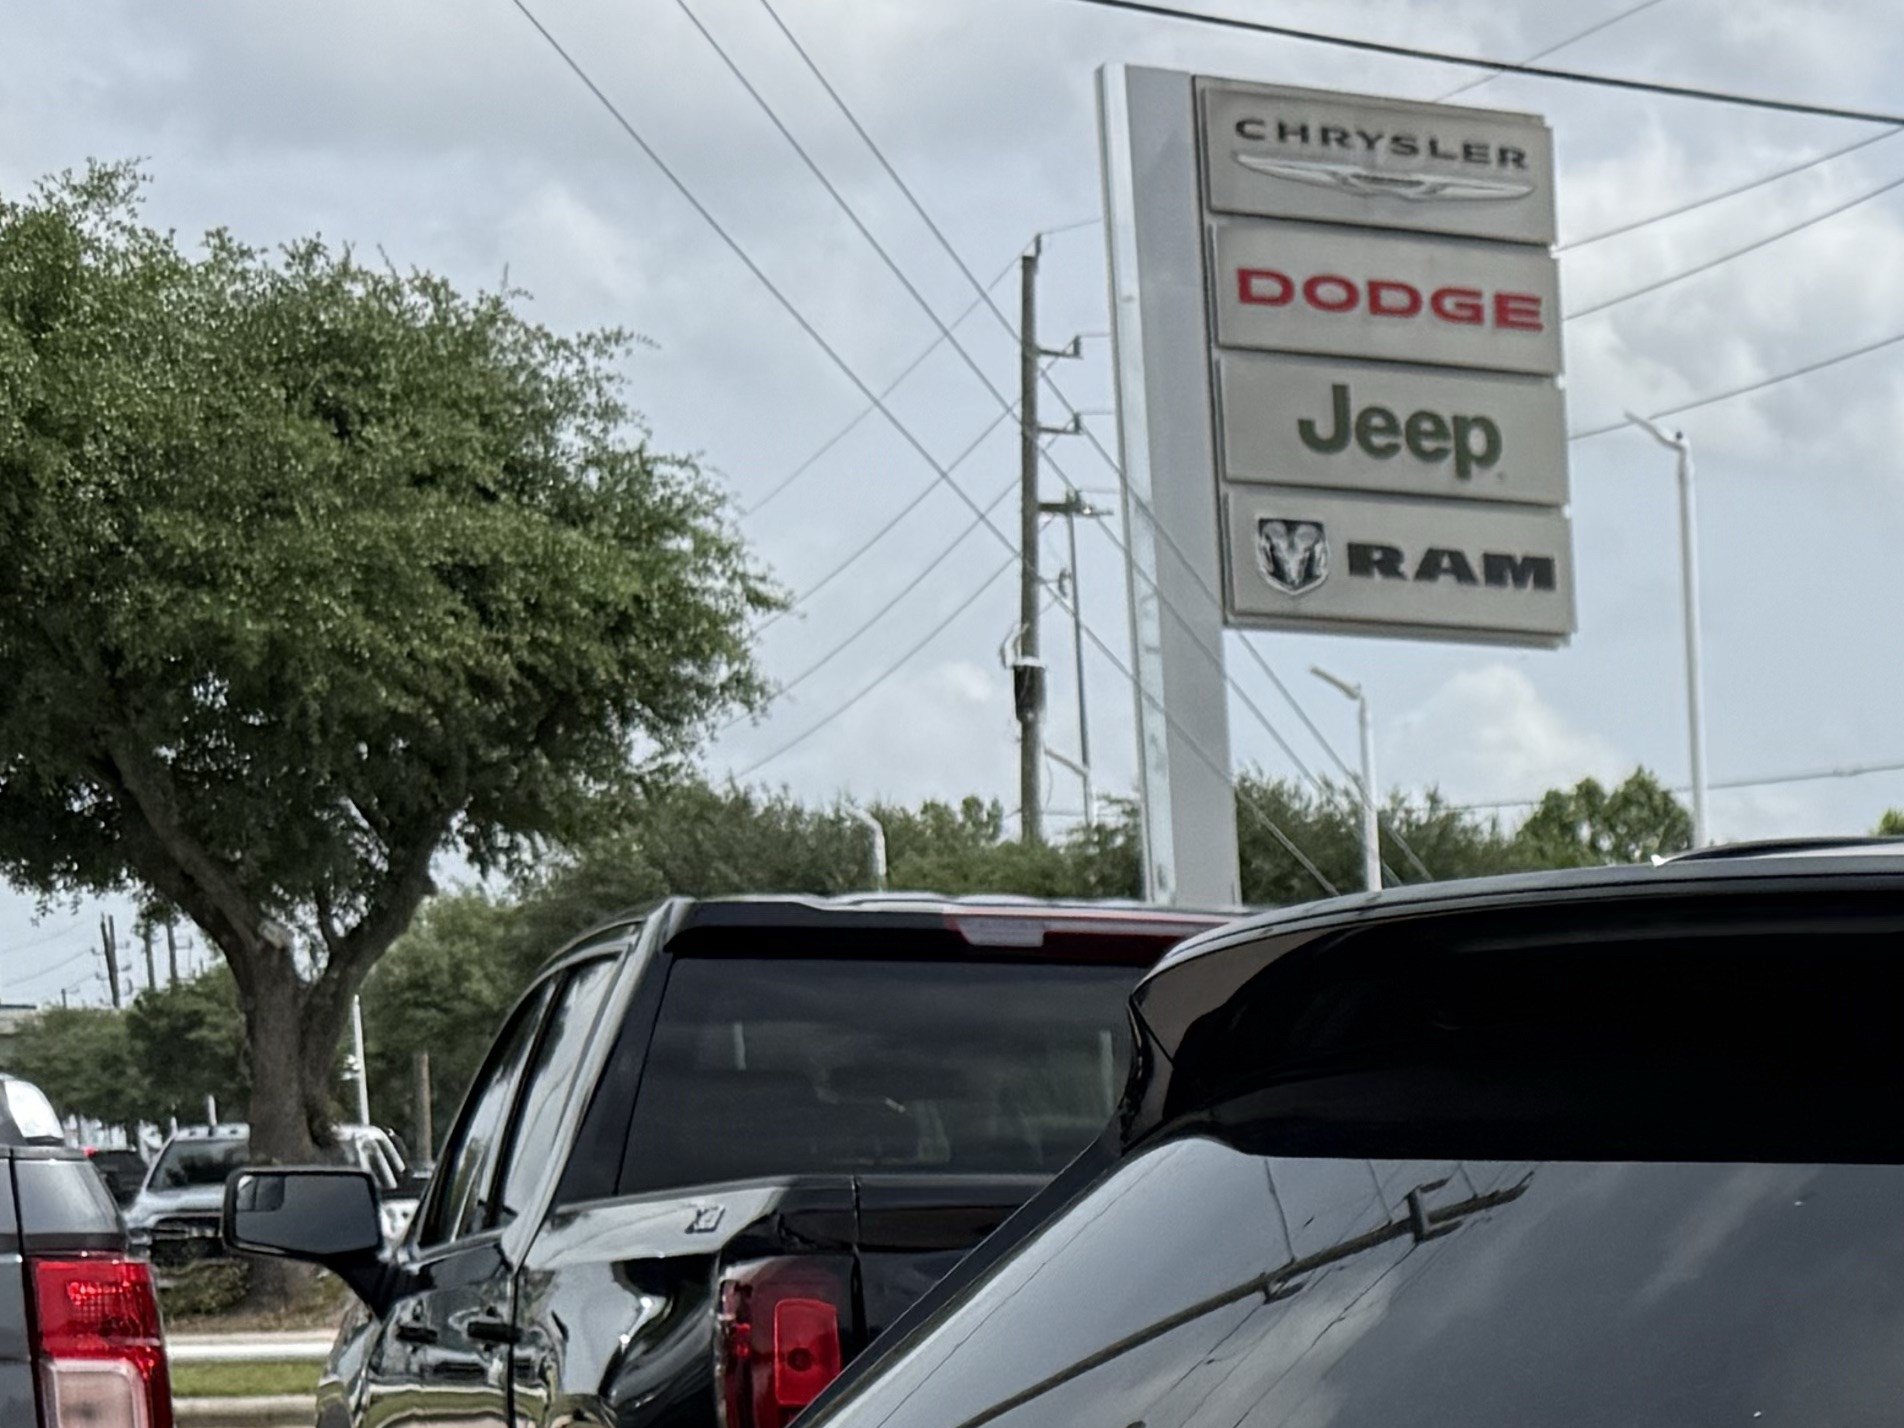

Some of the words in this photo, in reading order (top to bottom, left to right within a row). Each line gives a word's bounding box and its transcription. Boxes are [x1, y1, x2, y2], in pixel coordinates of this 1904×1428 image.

[1234, 118, 1528, 170] CHRYSLER
[1236, 268, 1544, 332] DODGE
[1298, 383, 1502, 479] Jeep
[1346, 541, 1557, 592] RAM
